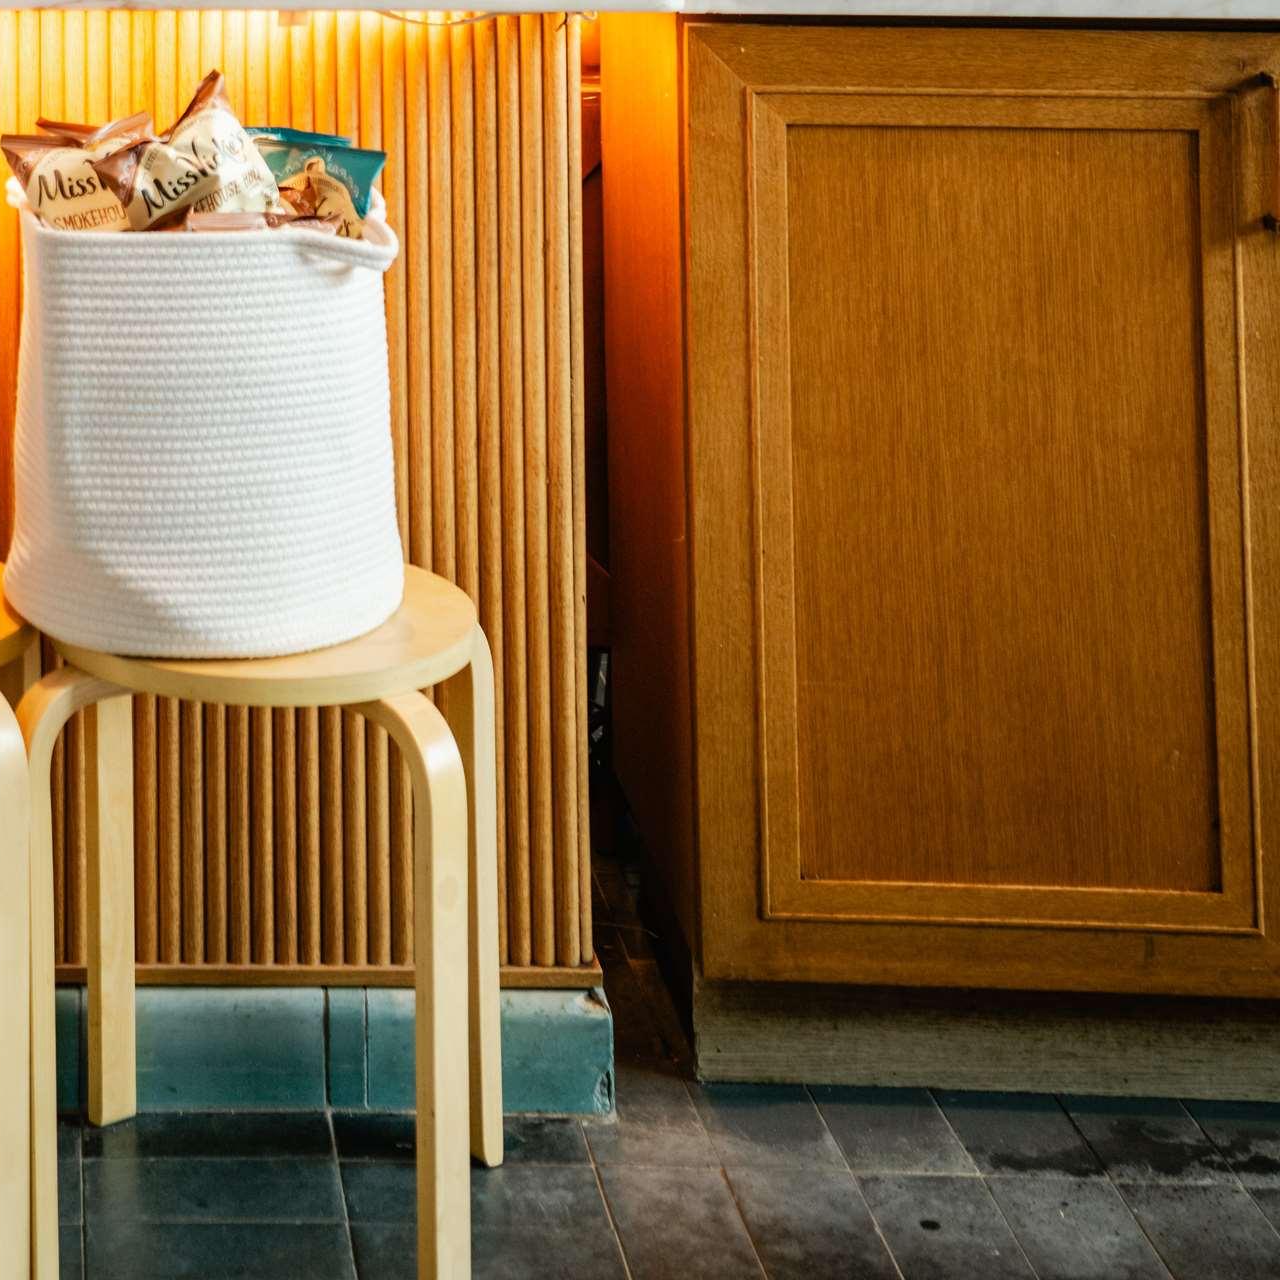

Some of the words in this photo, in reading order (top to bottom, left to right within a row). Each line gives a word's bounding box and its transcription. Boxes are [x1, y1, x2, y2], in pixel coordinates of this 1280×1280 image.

[36, 169, 96, 207] Miss
[141, 173, 199, 219] Miss
[53, 205, 126, 231] SMOKEHOU
